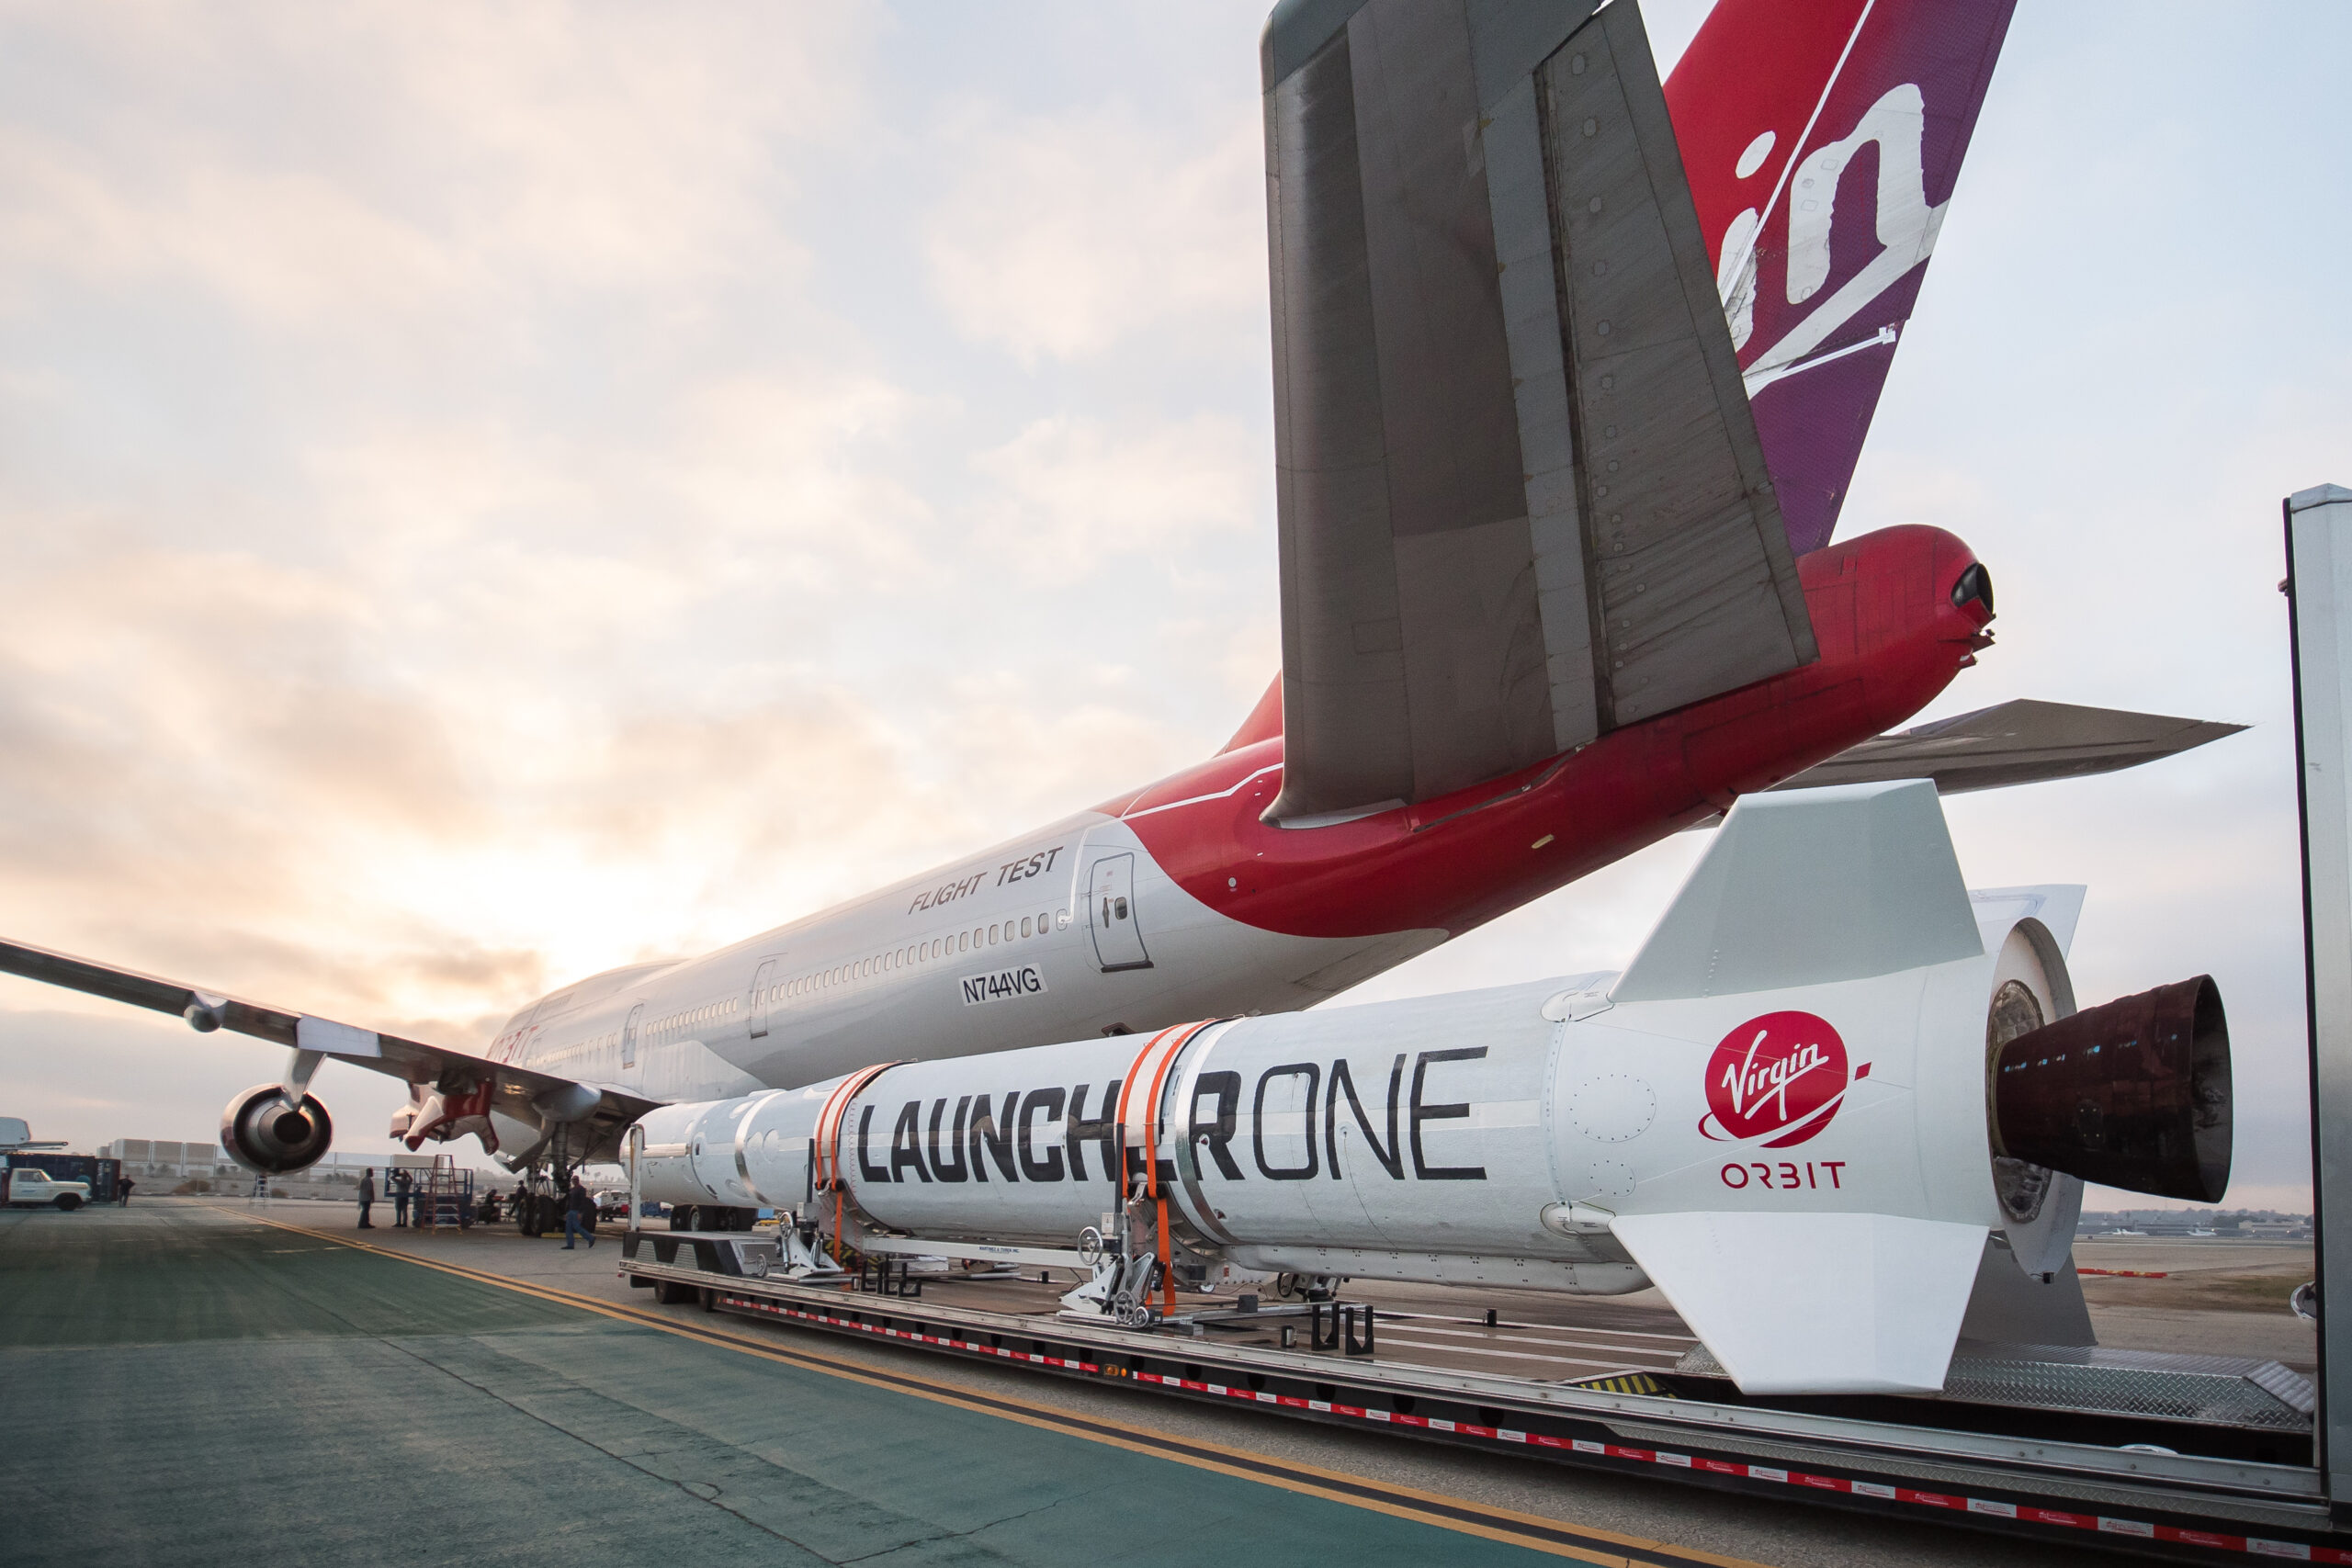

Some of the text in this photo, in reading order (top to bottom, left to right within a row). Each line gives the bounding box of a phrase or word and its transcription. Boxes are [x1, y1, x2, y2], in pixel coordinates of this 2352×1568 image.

[908, 846, 1064, 915] FLIGHT TEST
[962, 967, 1041, 1004] N744VG
[1721, 1030, 1829, 1122] Virgin
[1721, 1161, 1846, 1190] ORBIT
